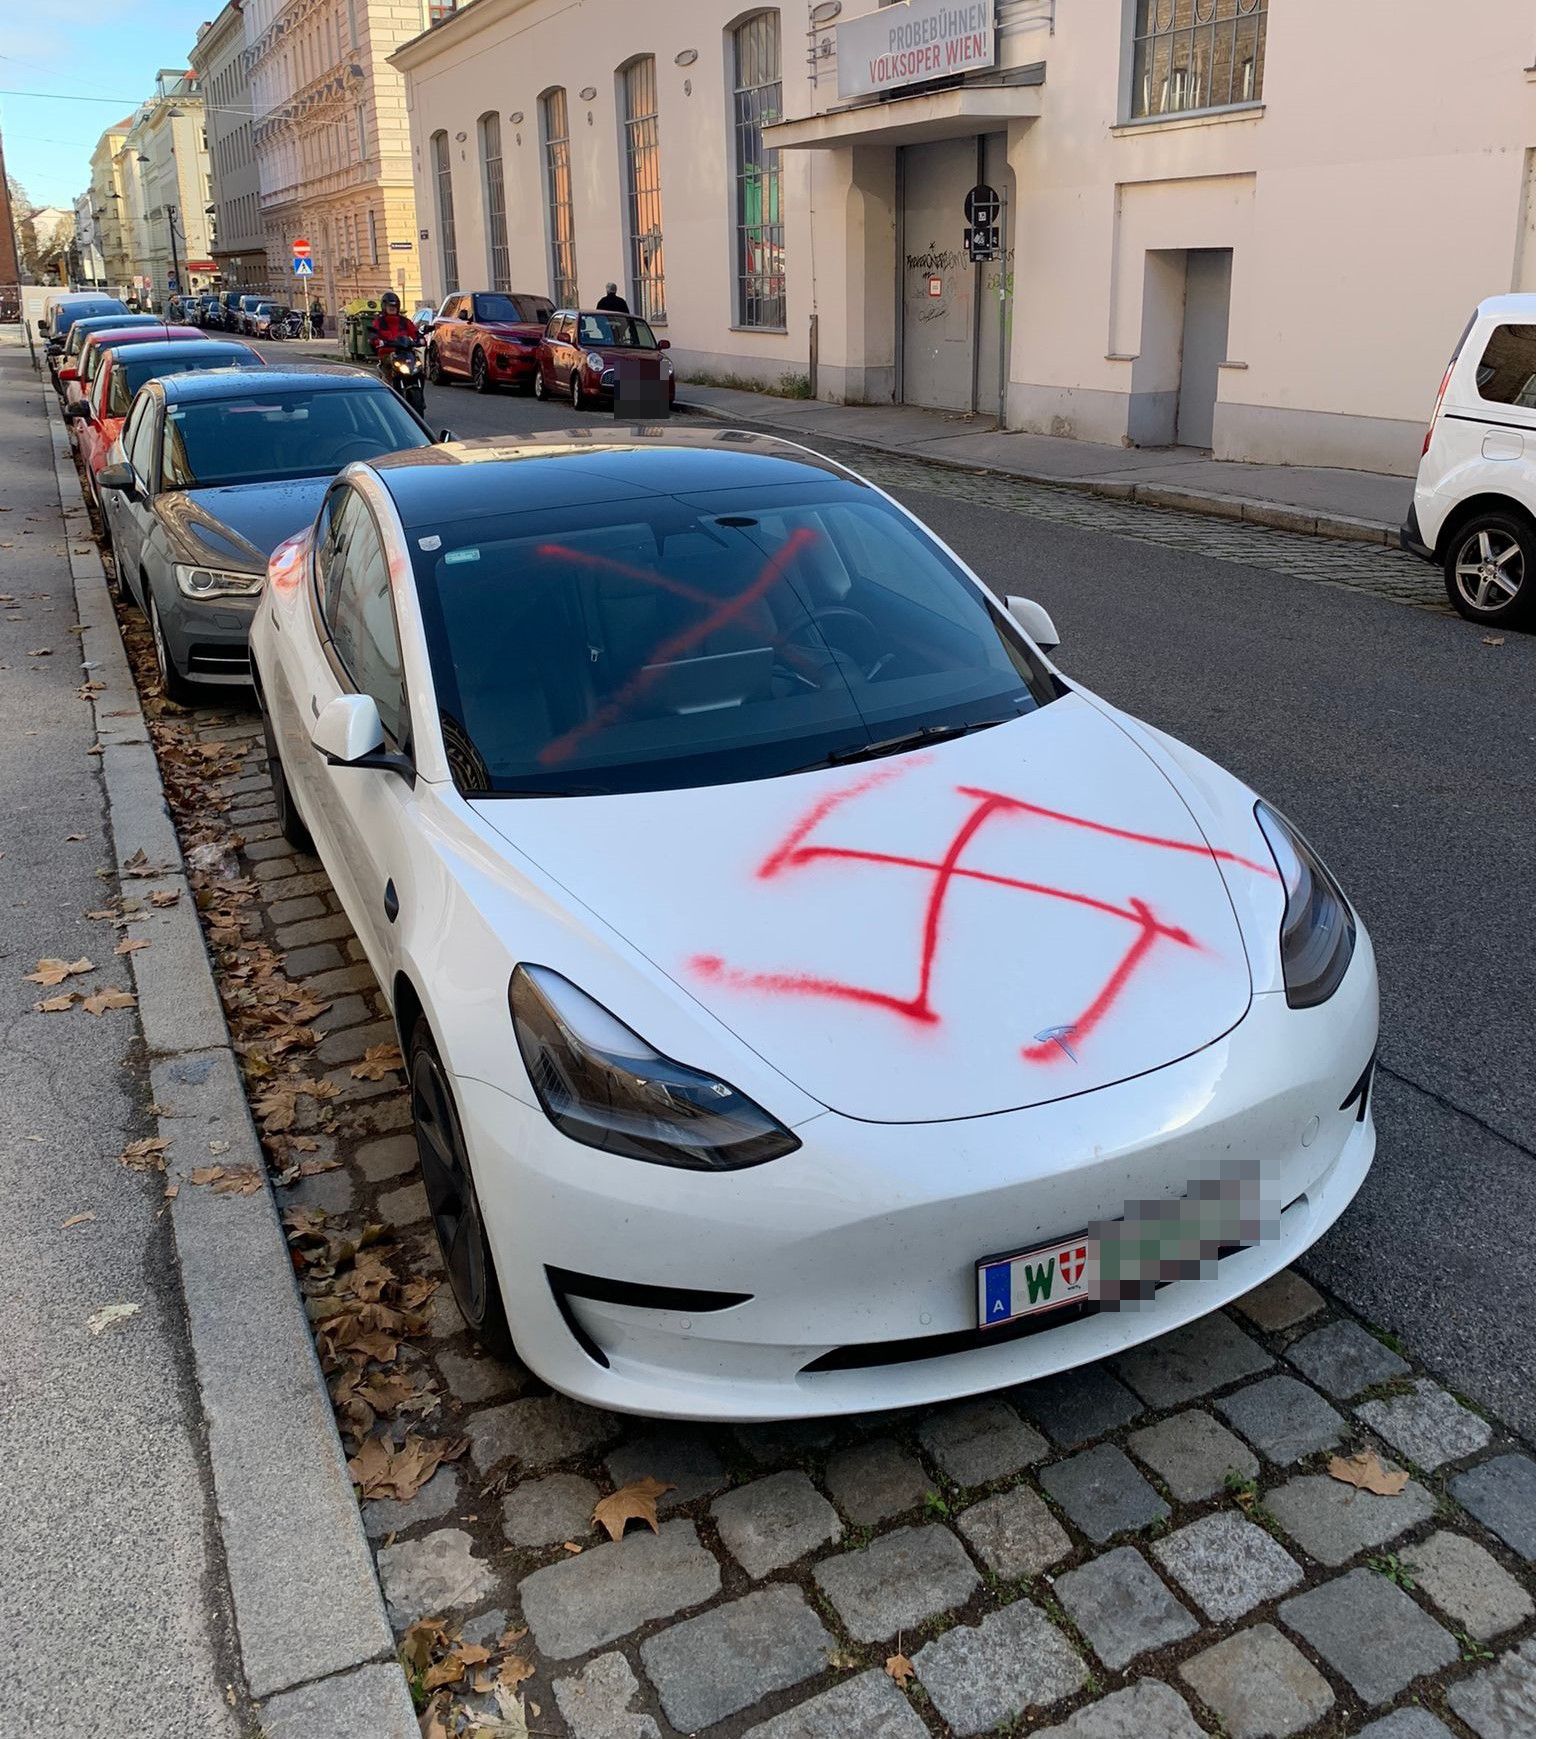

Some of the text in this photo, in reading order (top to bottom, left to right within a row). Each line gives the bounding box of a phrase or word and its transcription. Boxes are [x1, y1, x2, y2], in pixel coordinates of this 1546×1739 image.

[889, 2, 987, 52] PROBEBÜHNEN
[869, 31, 987, 84] VOLKSOPER WIEN!
[1025, 1257, 1055, 1304] W
[992, 1299, 1005, 1314] A
